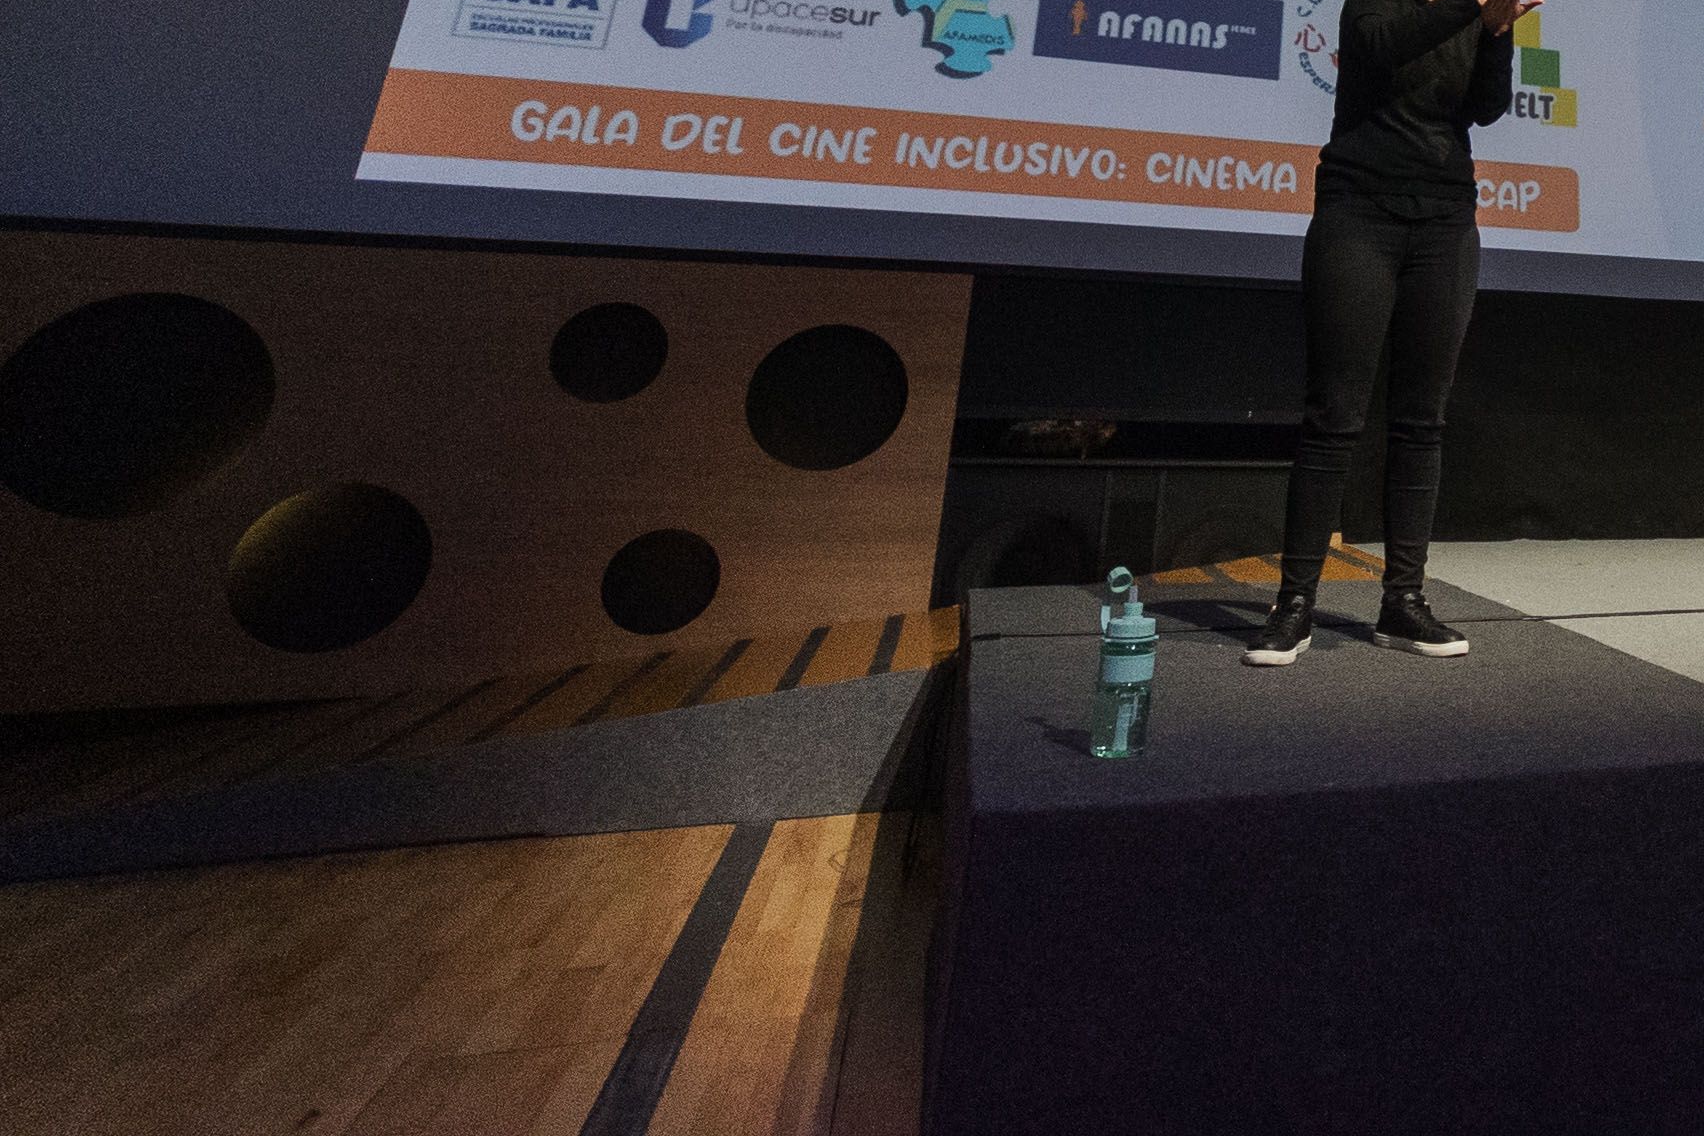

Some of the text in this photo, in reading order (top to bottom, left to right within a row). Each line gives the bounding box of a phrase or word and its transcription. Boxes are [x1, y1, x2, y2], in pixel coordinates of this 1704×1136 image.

[1508, 91, 1554, 120] ELT
[510, 100, 1541, 213] GALA DEL CINE INCLUSIVO: CINEMA CAP
